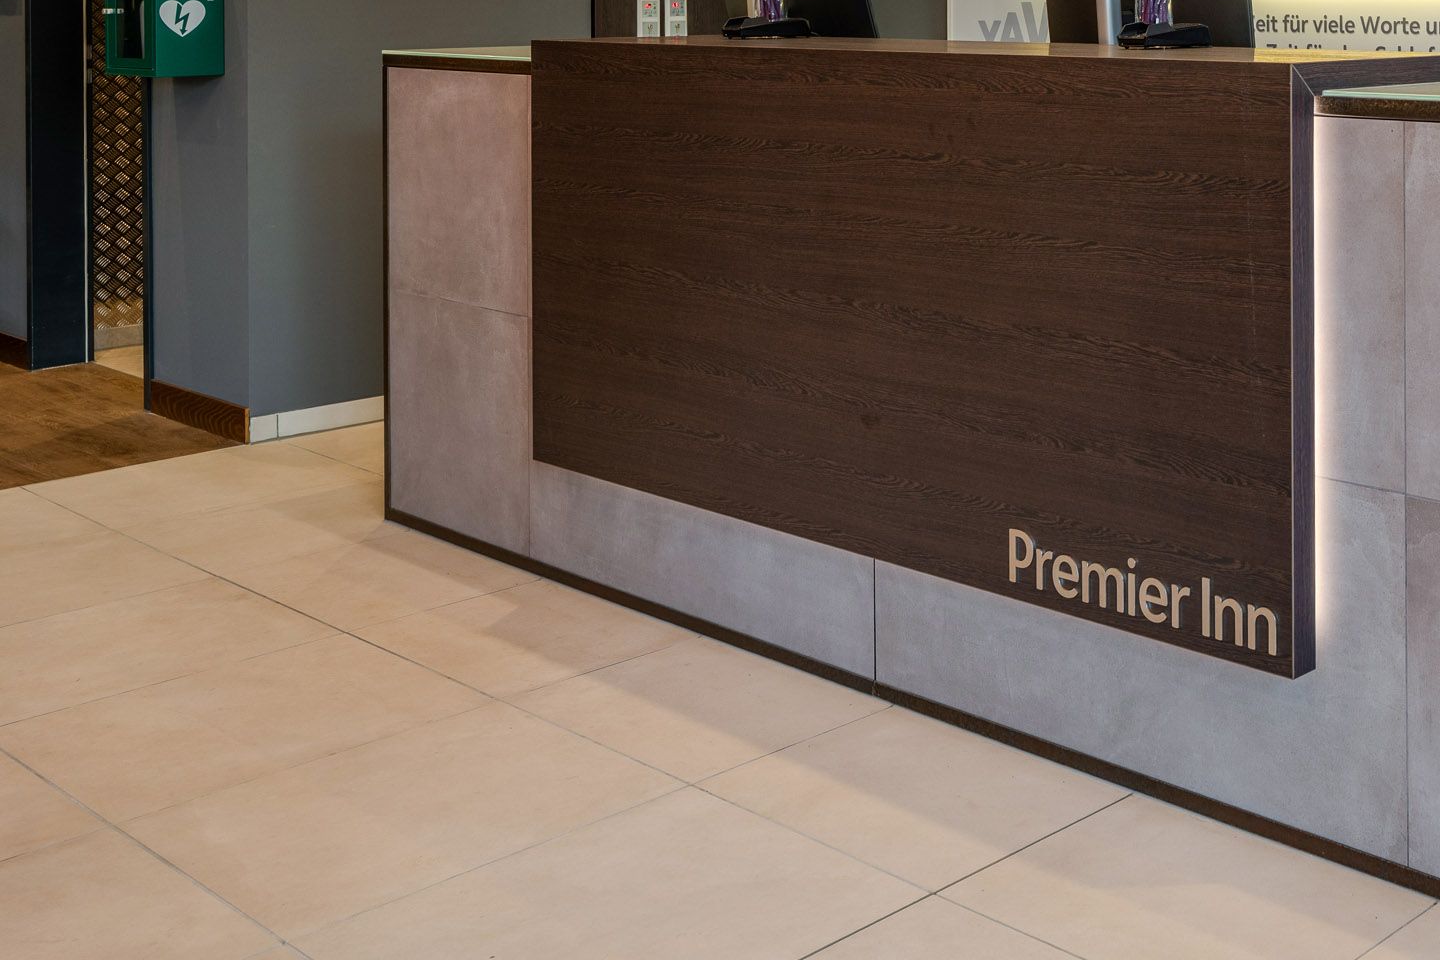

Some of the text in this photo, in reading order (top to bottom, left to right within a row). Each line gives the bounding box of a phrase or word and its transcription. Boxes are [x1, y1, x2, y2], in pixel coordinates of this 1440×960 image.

[1251, 15, 1278, 34] eit
[1282, 14, 1309, 34] für
[1312, 14, 1355, 34] viele
[1360, 16, 1421, 35] Worte
[1008, 527, 1278, 657] Premier Inn
